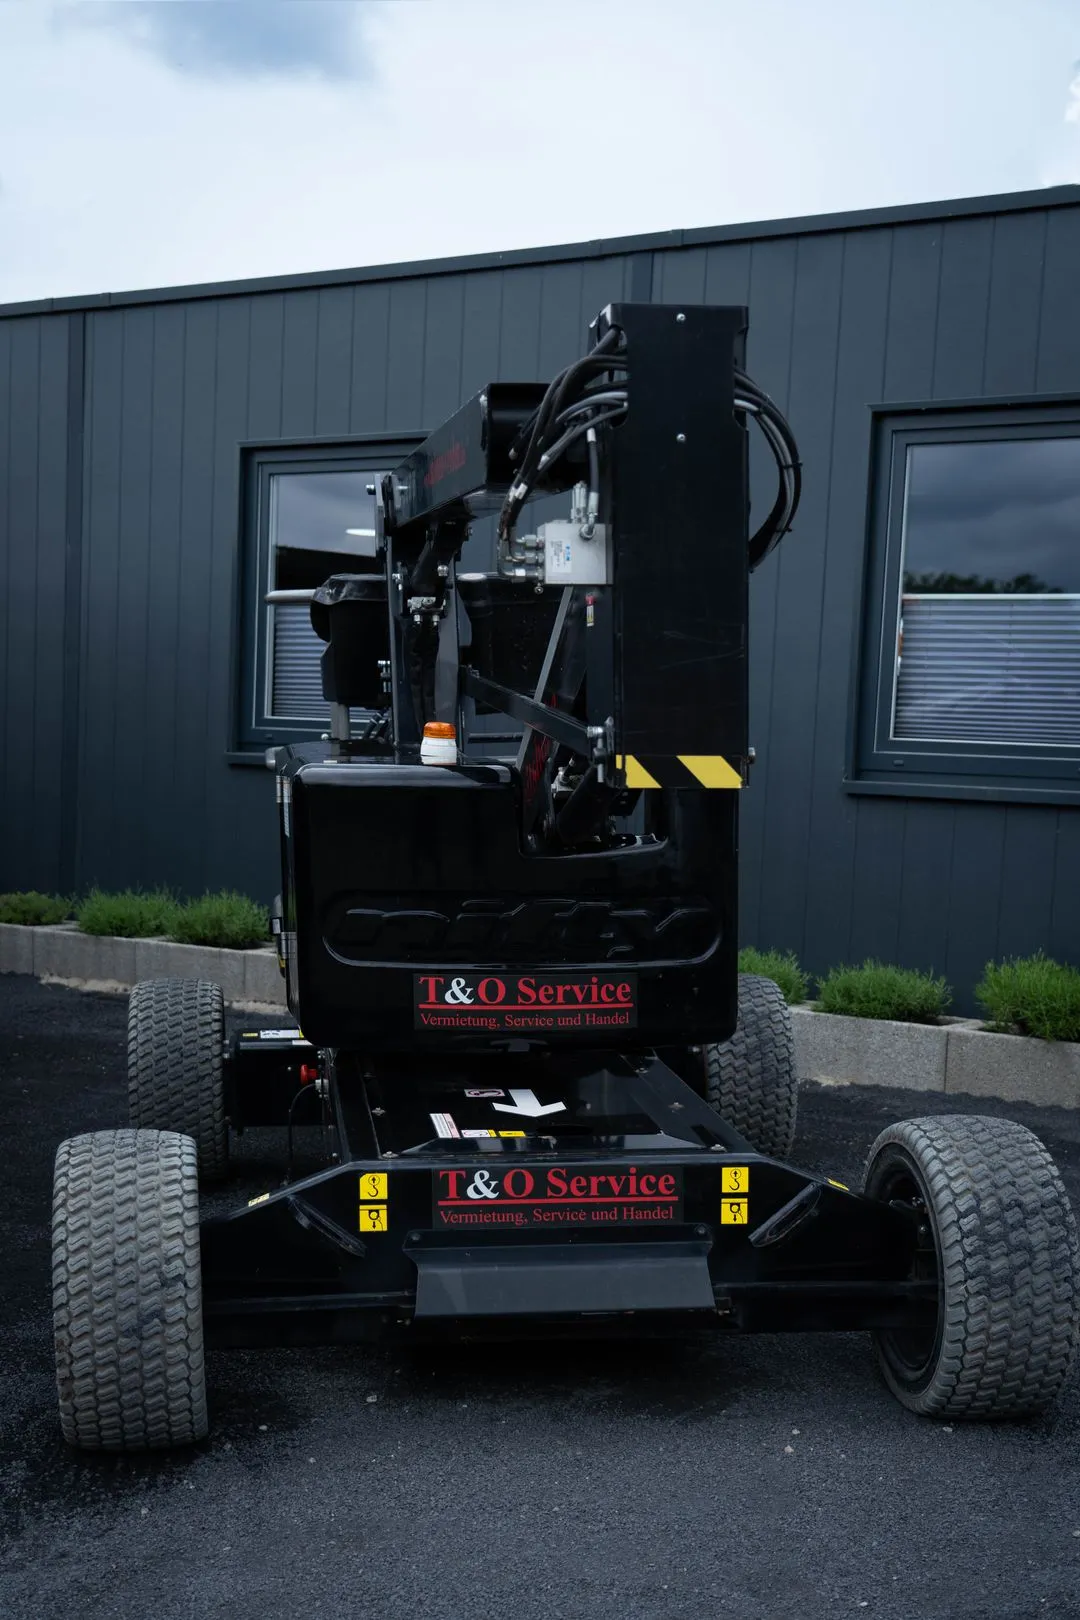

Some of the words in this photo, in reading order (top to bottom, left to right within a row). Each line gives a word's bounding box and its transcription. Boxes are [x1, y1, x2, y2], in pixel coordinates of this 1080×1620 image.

[418, 976, 506, 1004] T&O
[516, 975, 632, 1004] Service
[420, 1013, 500, 1030] Vermietung,
[504, 1012, 554, 1028] Service
[557, 1012, 581, 1026] und
[585, 1011, 629, 1025] Handel
[439, 1168, 534, 1199] T&O
[546, 1166, 676, 1197] Service
[440, 1208, 529, 1226] Vermietung,
[532, 1207, 588, 1222] Service
[591, 1206, 618, 1221] und
[622, 1205, 673, 1221] Handel
